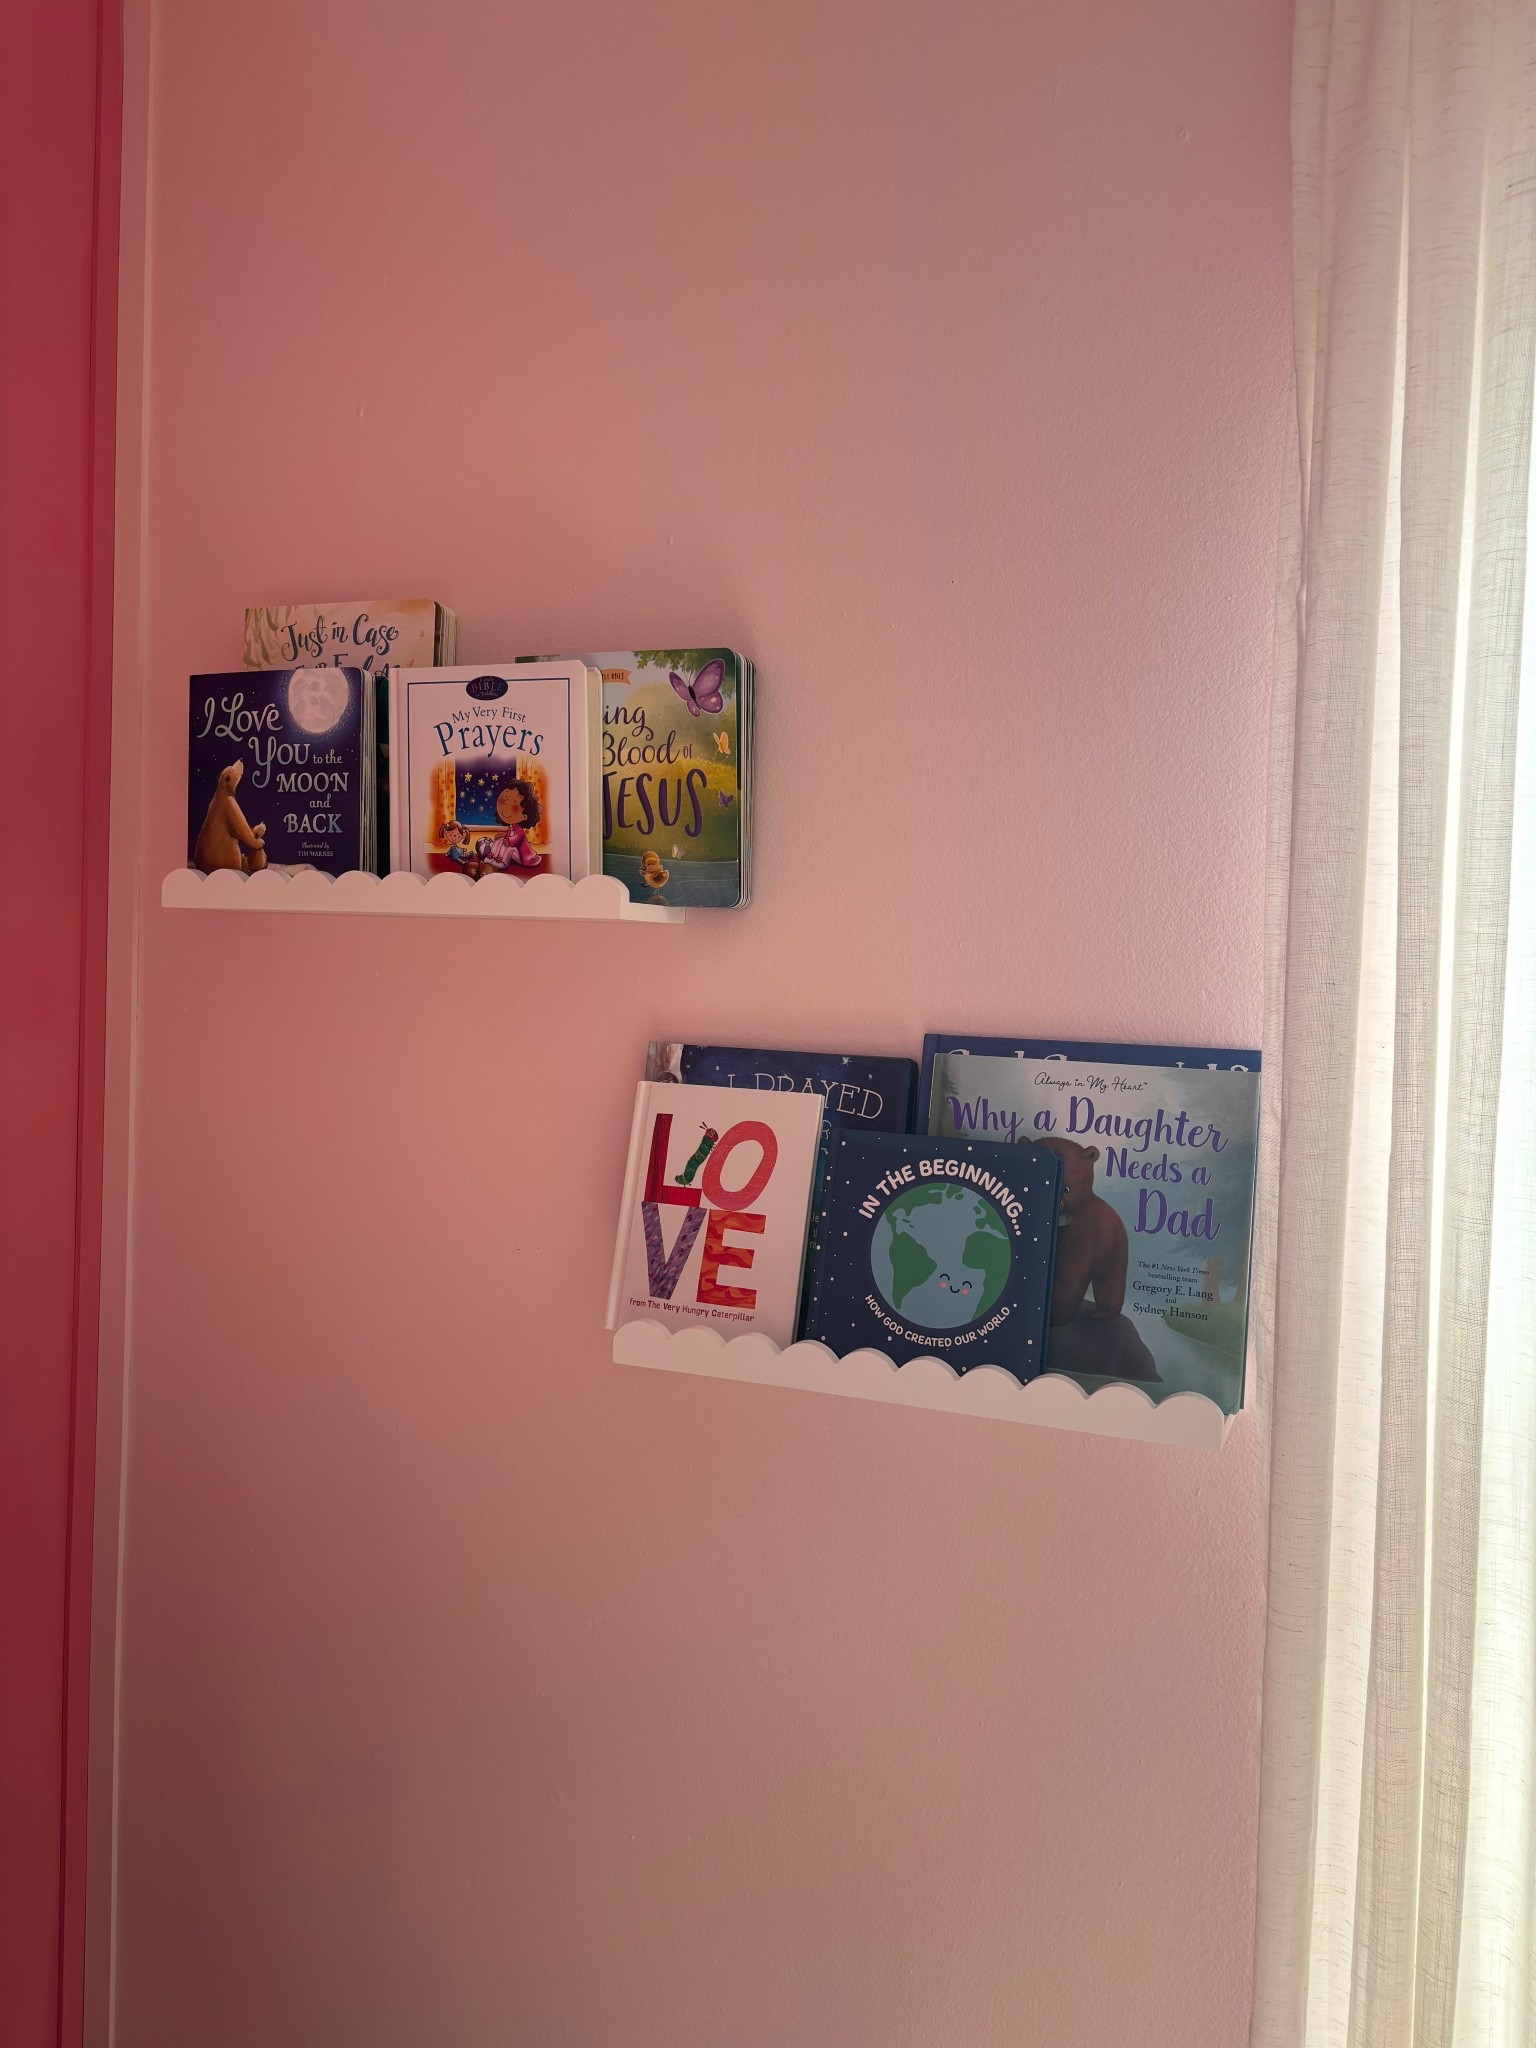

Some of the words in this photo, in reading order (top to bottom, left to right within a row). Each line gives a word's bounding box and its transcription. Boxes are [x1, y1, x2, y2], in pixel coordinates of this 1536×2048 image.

[280, 615, 329, 662] Just
[331, 621, 348, 643] in
[352, 613, 399, 656] Case
[471, 681, 504, 693] BIBLE
[196, 697, 216, 738] I
[214, 692, 283, 742] Love
[451, 710, 471, 724] My
[472, 706, 498, 720] Very
[502, 706, 527, 723] First
[433, 721, 544, 758] Prayers
[602, 730, 680, 767] Blood
[312, 753, 323, 764] to
[324, 749, 344, 764] the
[276, 772, 350, 793] MOON
[309, 793, 332, 808] and
[602, 768, 708, 840] JESUS
[283, 812, 343, 834] BACK
[1034, 1071, 1072, 1092] Always
[1074, 1078, 1085, 1087] in
[1086, 1074, 1109, 1094] My
[946, 1095, 1024, 1144] Why
[1033, 1109, 1058, 1132] a
[1066, 1095, 1229, 1153] Daughter
[1105, 1146, 1183, 1184] Needs
[1191, 1166, 1212, 1186] a
[858, 1194, 881, 1219] IN
[875, 1164, 916, 1196] THE
[918, 1158, 1024, 1236] BEGINNING...
[1134, 1188, 1221, 1241] Dad
[1137, 1260, 1150, 1269] The
[1160, 1264, 1175, 1272] New
[1176, 1265, 1190, 1273] York
[1191, 1267, 1210, 1275] Times
[1147, 1271, 1180, 1283] bestselling
[1132, 1280, 1172, 1296] Gregory
[1174, 1285, 1185, 1296] E.
[1188, 1286, 1214, 1302] Lang
[629, 1298, 646, 1307] from
[647, 1300, 661, 1309] The
[663, 1302, 681, 1314] Very
[682, 1305, 710, 1319] Hungry
[711, 1309, 755, 1322] Caterpillar
[864, 1294, 885, 1319] HOW
[882, 1316, 904, 1336] GOD
[904, 1330, 952, 1347] CREATED
[954, 1331, 978, 1346] OUR
[976, 1306, 1011, 1337] WORLD
[1132, 1302, 1168, 1318] Sydney
[1170, 1306, 1208, 1321] Hanson
